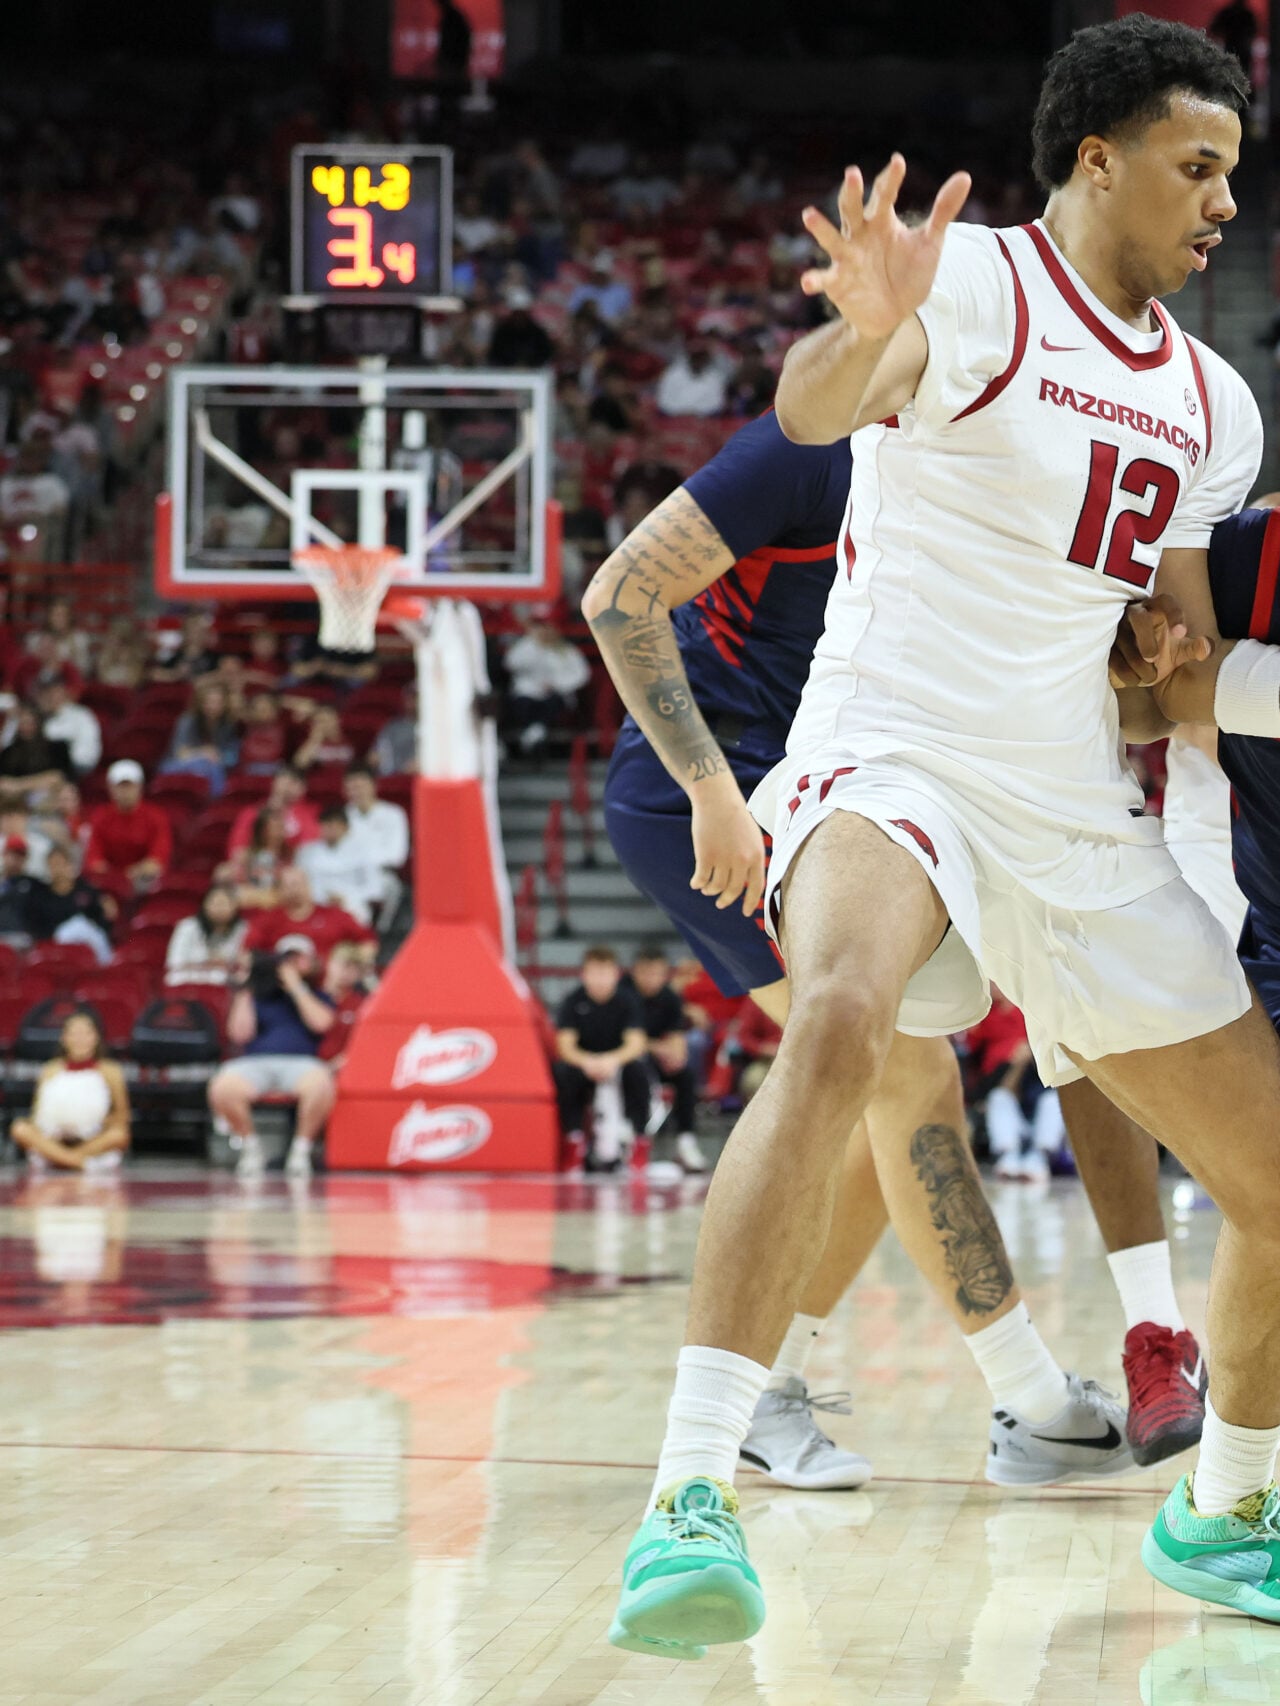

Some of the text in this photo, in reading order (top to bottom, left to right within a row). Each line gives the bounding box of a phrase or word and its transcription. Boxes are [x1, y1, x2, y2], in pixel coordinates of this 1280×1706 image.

[327, 208, 416, 288] 3.4
[1039, 377, 1200, 467] RAZORBACKS
[1066, 438, 1180, 589] 12
[658, 689, 689, 715] 65
